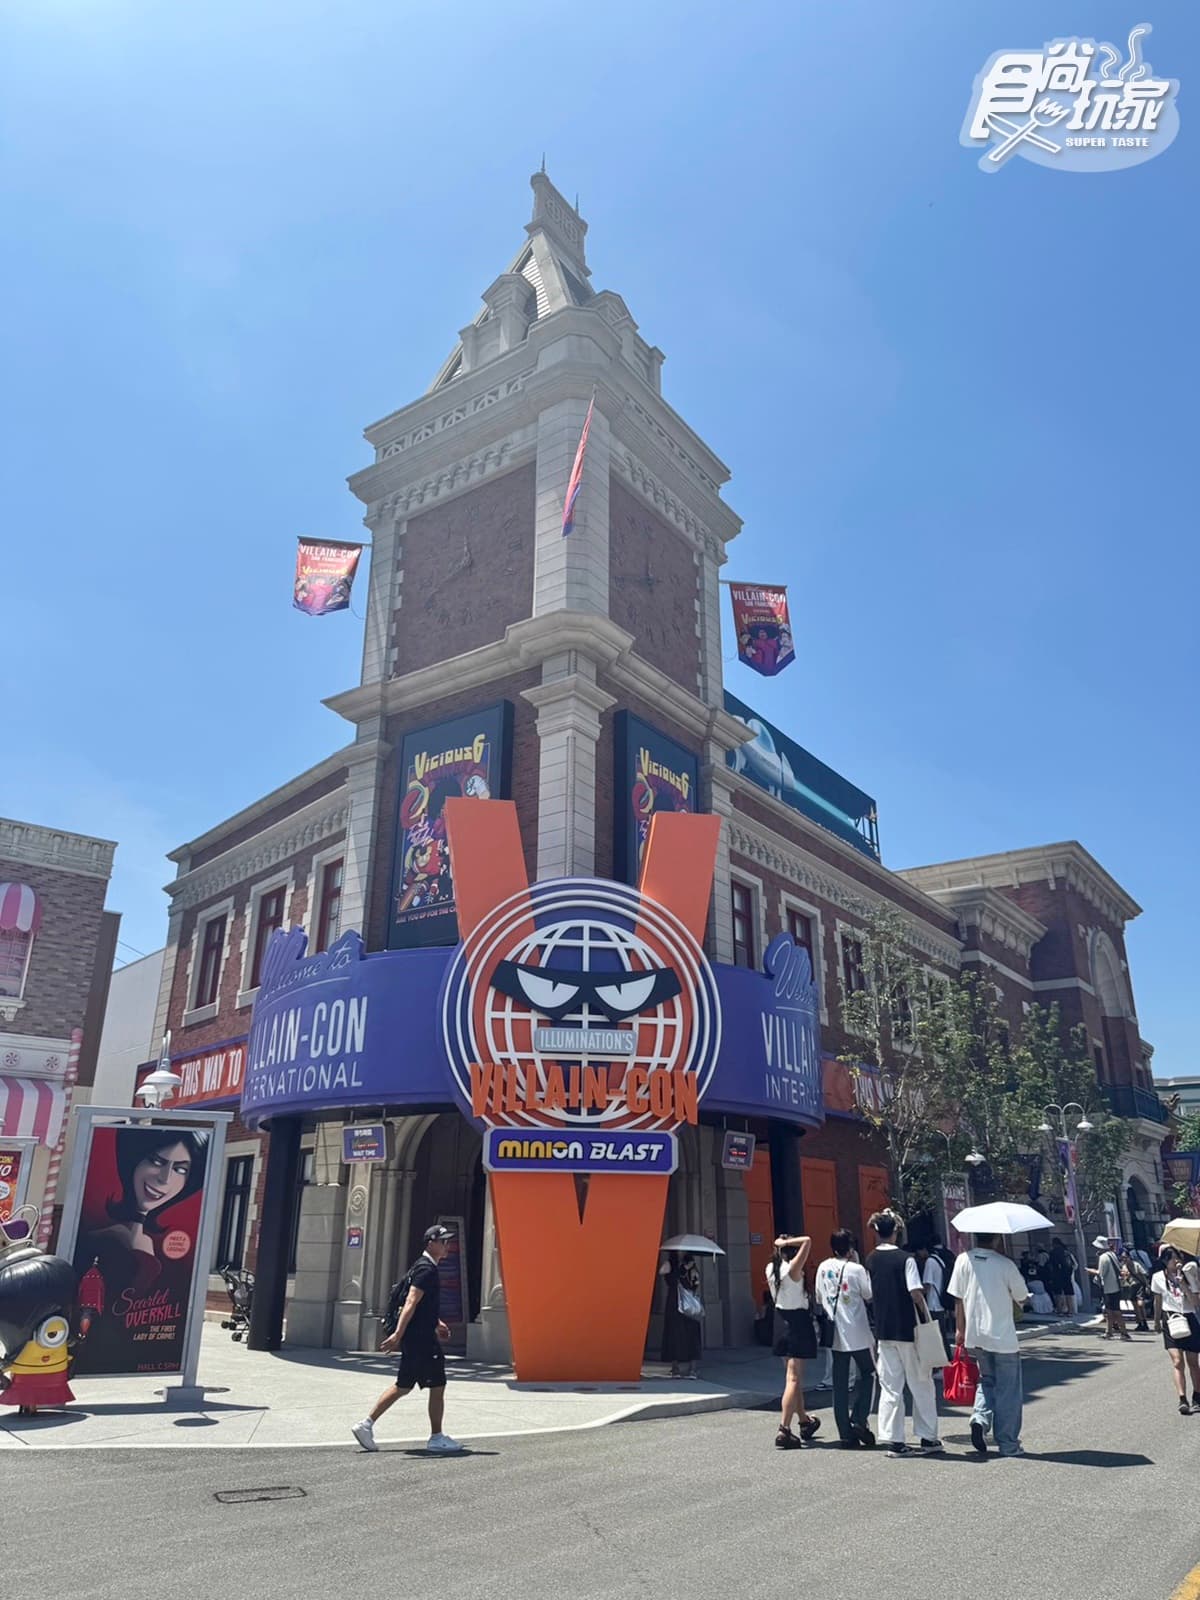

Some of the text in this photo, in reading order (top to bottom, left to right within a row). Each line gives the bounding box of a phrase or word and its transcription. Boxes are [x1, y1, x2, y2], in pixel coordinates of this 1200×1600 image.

[331, 942, 353, 970] to
[540, 1030, 634, 1050] ILLUMINATION'S
[179, 1048, 243, 1098] THIS WAY TO
[470, 1062, 698, 1126] VILLAIN-CON
[589, 1142, 664, 1161] BLAST
[125, 1302, 182, 1328] OVERKILL
